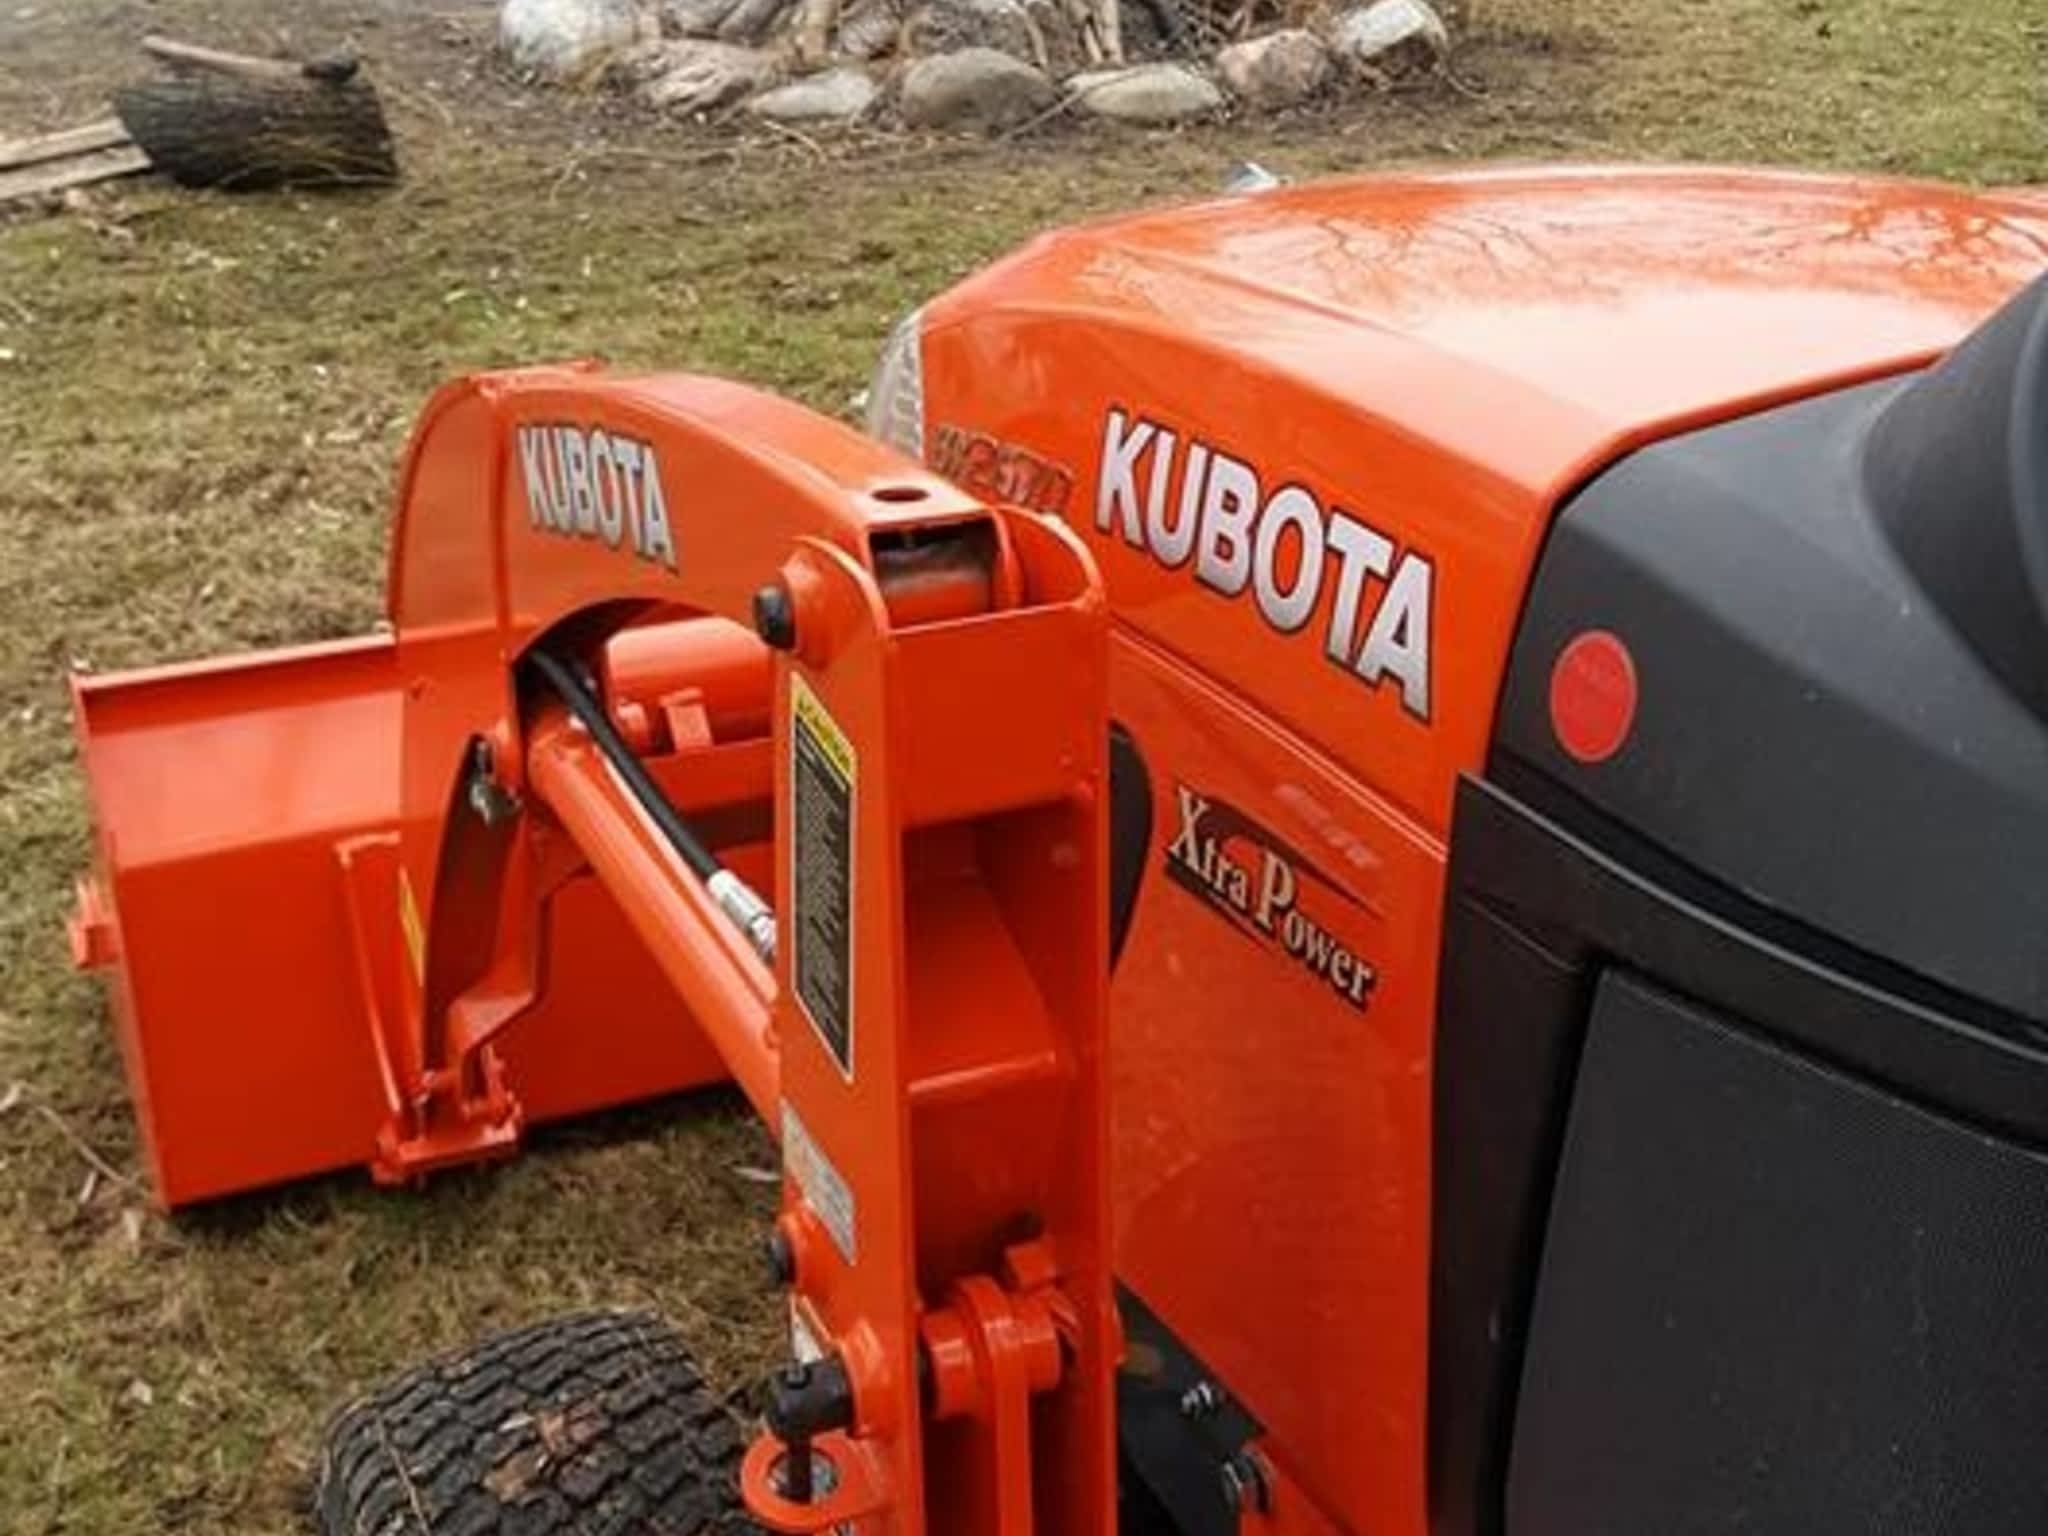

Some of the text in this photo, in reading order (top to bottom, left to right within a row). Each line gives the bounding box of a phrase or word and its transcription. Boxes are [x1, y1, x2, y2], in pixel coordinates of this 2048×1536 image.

[516, 422, 679, 574] KUBOTA
[1095, 406, 1434, 724] KUBOTA
[1168, 784, 1373, 1003] Xtra Power
